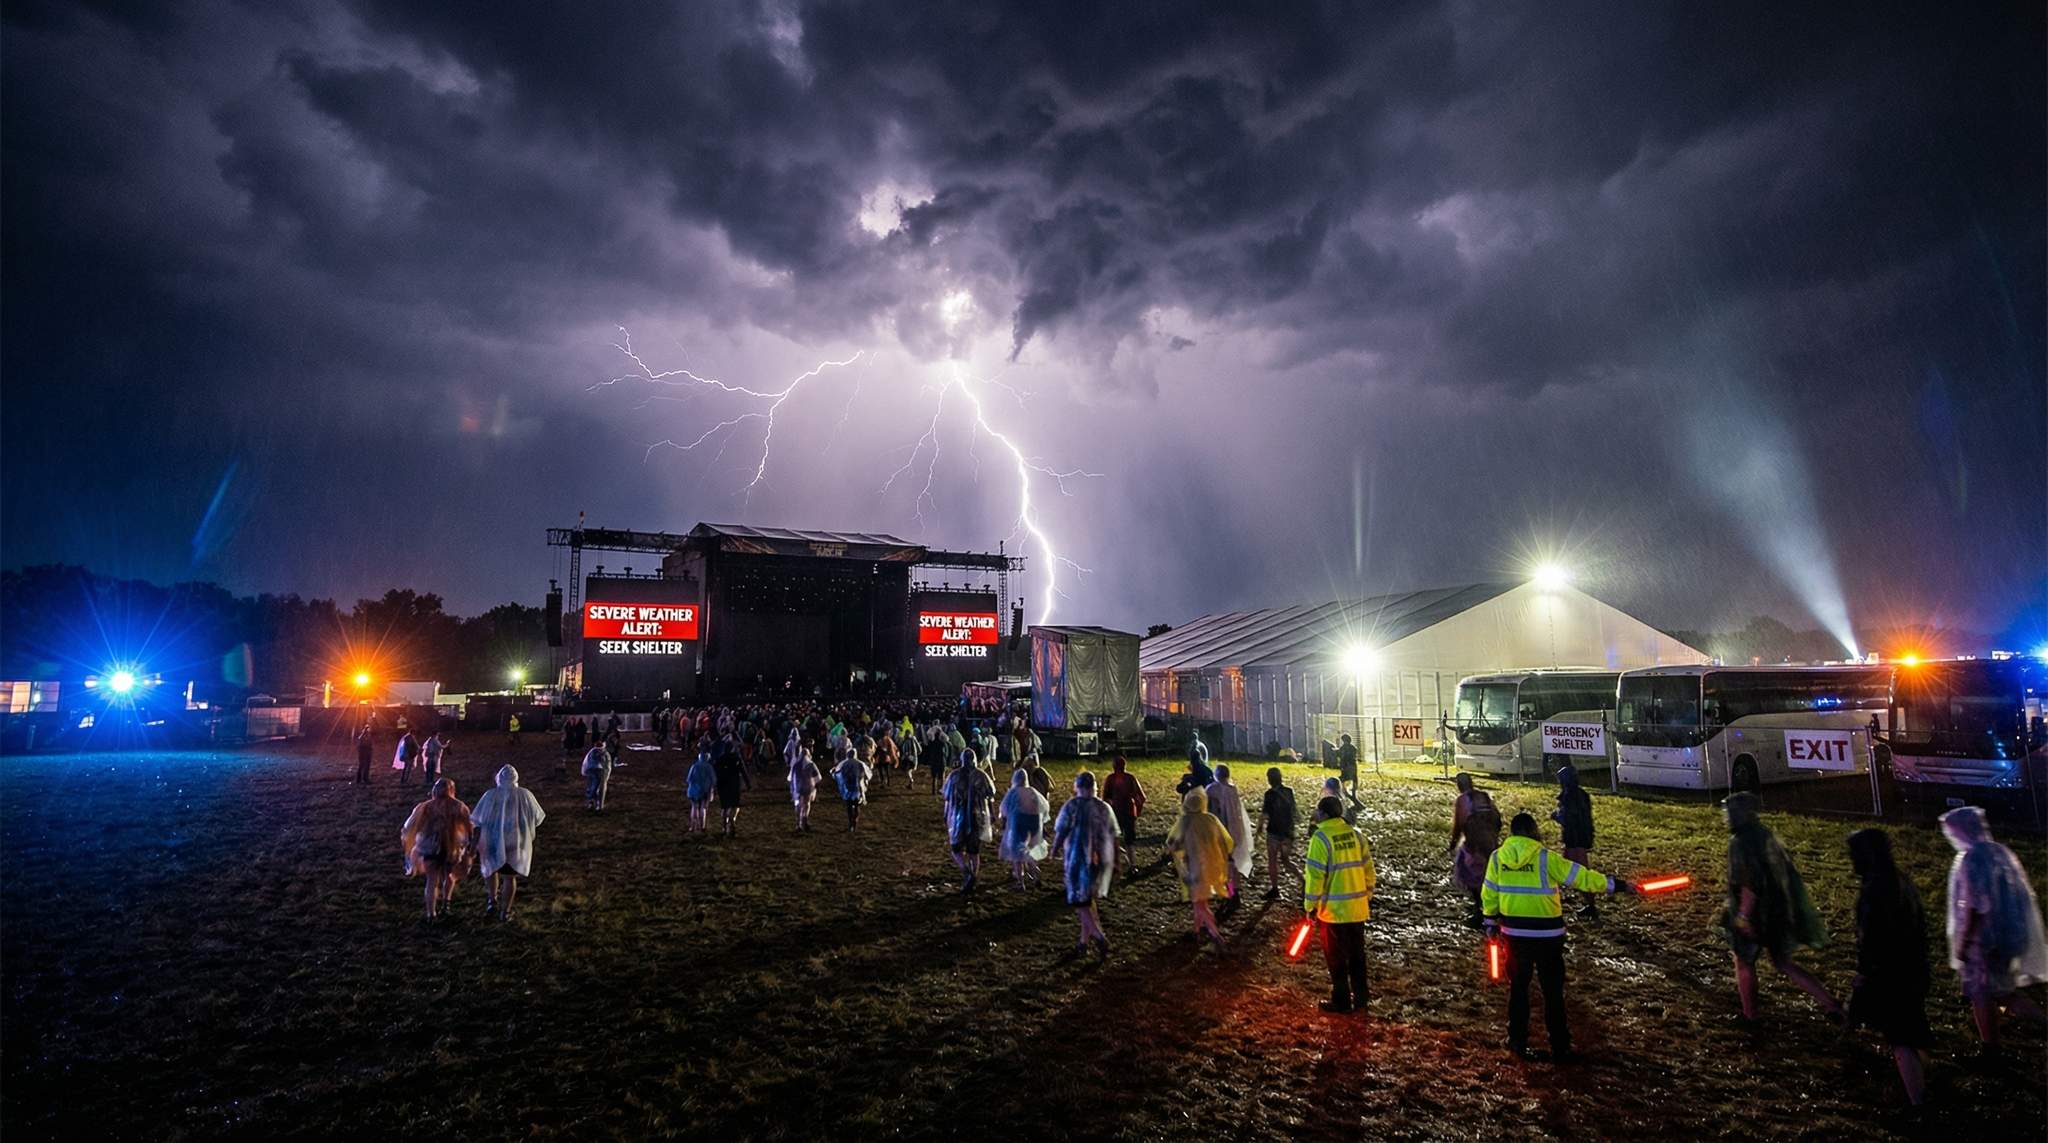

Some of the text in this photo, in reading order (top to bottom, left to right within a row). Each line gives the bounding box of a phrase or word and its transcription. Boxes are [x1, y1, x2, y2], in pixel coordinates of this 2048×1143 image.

[589, 606, 693, 622] SEVERE WEATHER
[621, 622, 662, 635] ALERT:
[920, 616, 995, 629] SEVERE WEATHER
[942, 629, 972, 641] ALERT:
[599, 641, 682, 655] SEEK SHELTER
[925, 645, 987, 657] SEEK SHELTER
[1394, 725, 1421, 740] EXIT
[1544, 725, 1602, 739] EMERGENCY
[1552, 738, 1594, 751] SHELTER
[1789, 739, 1849, 762] EXIT
